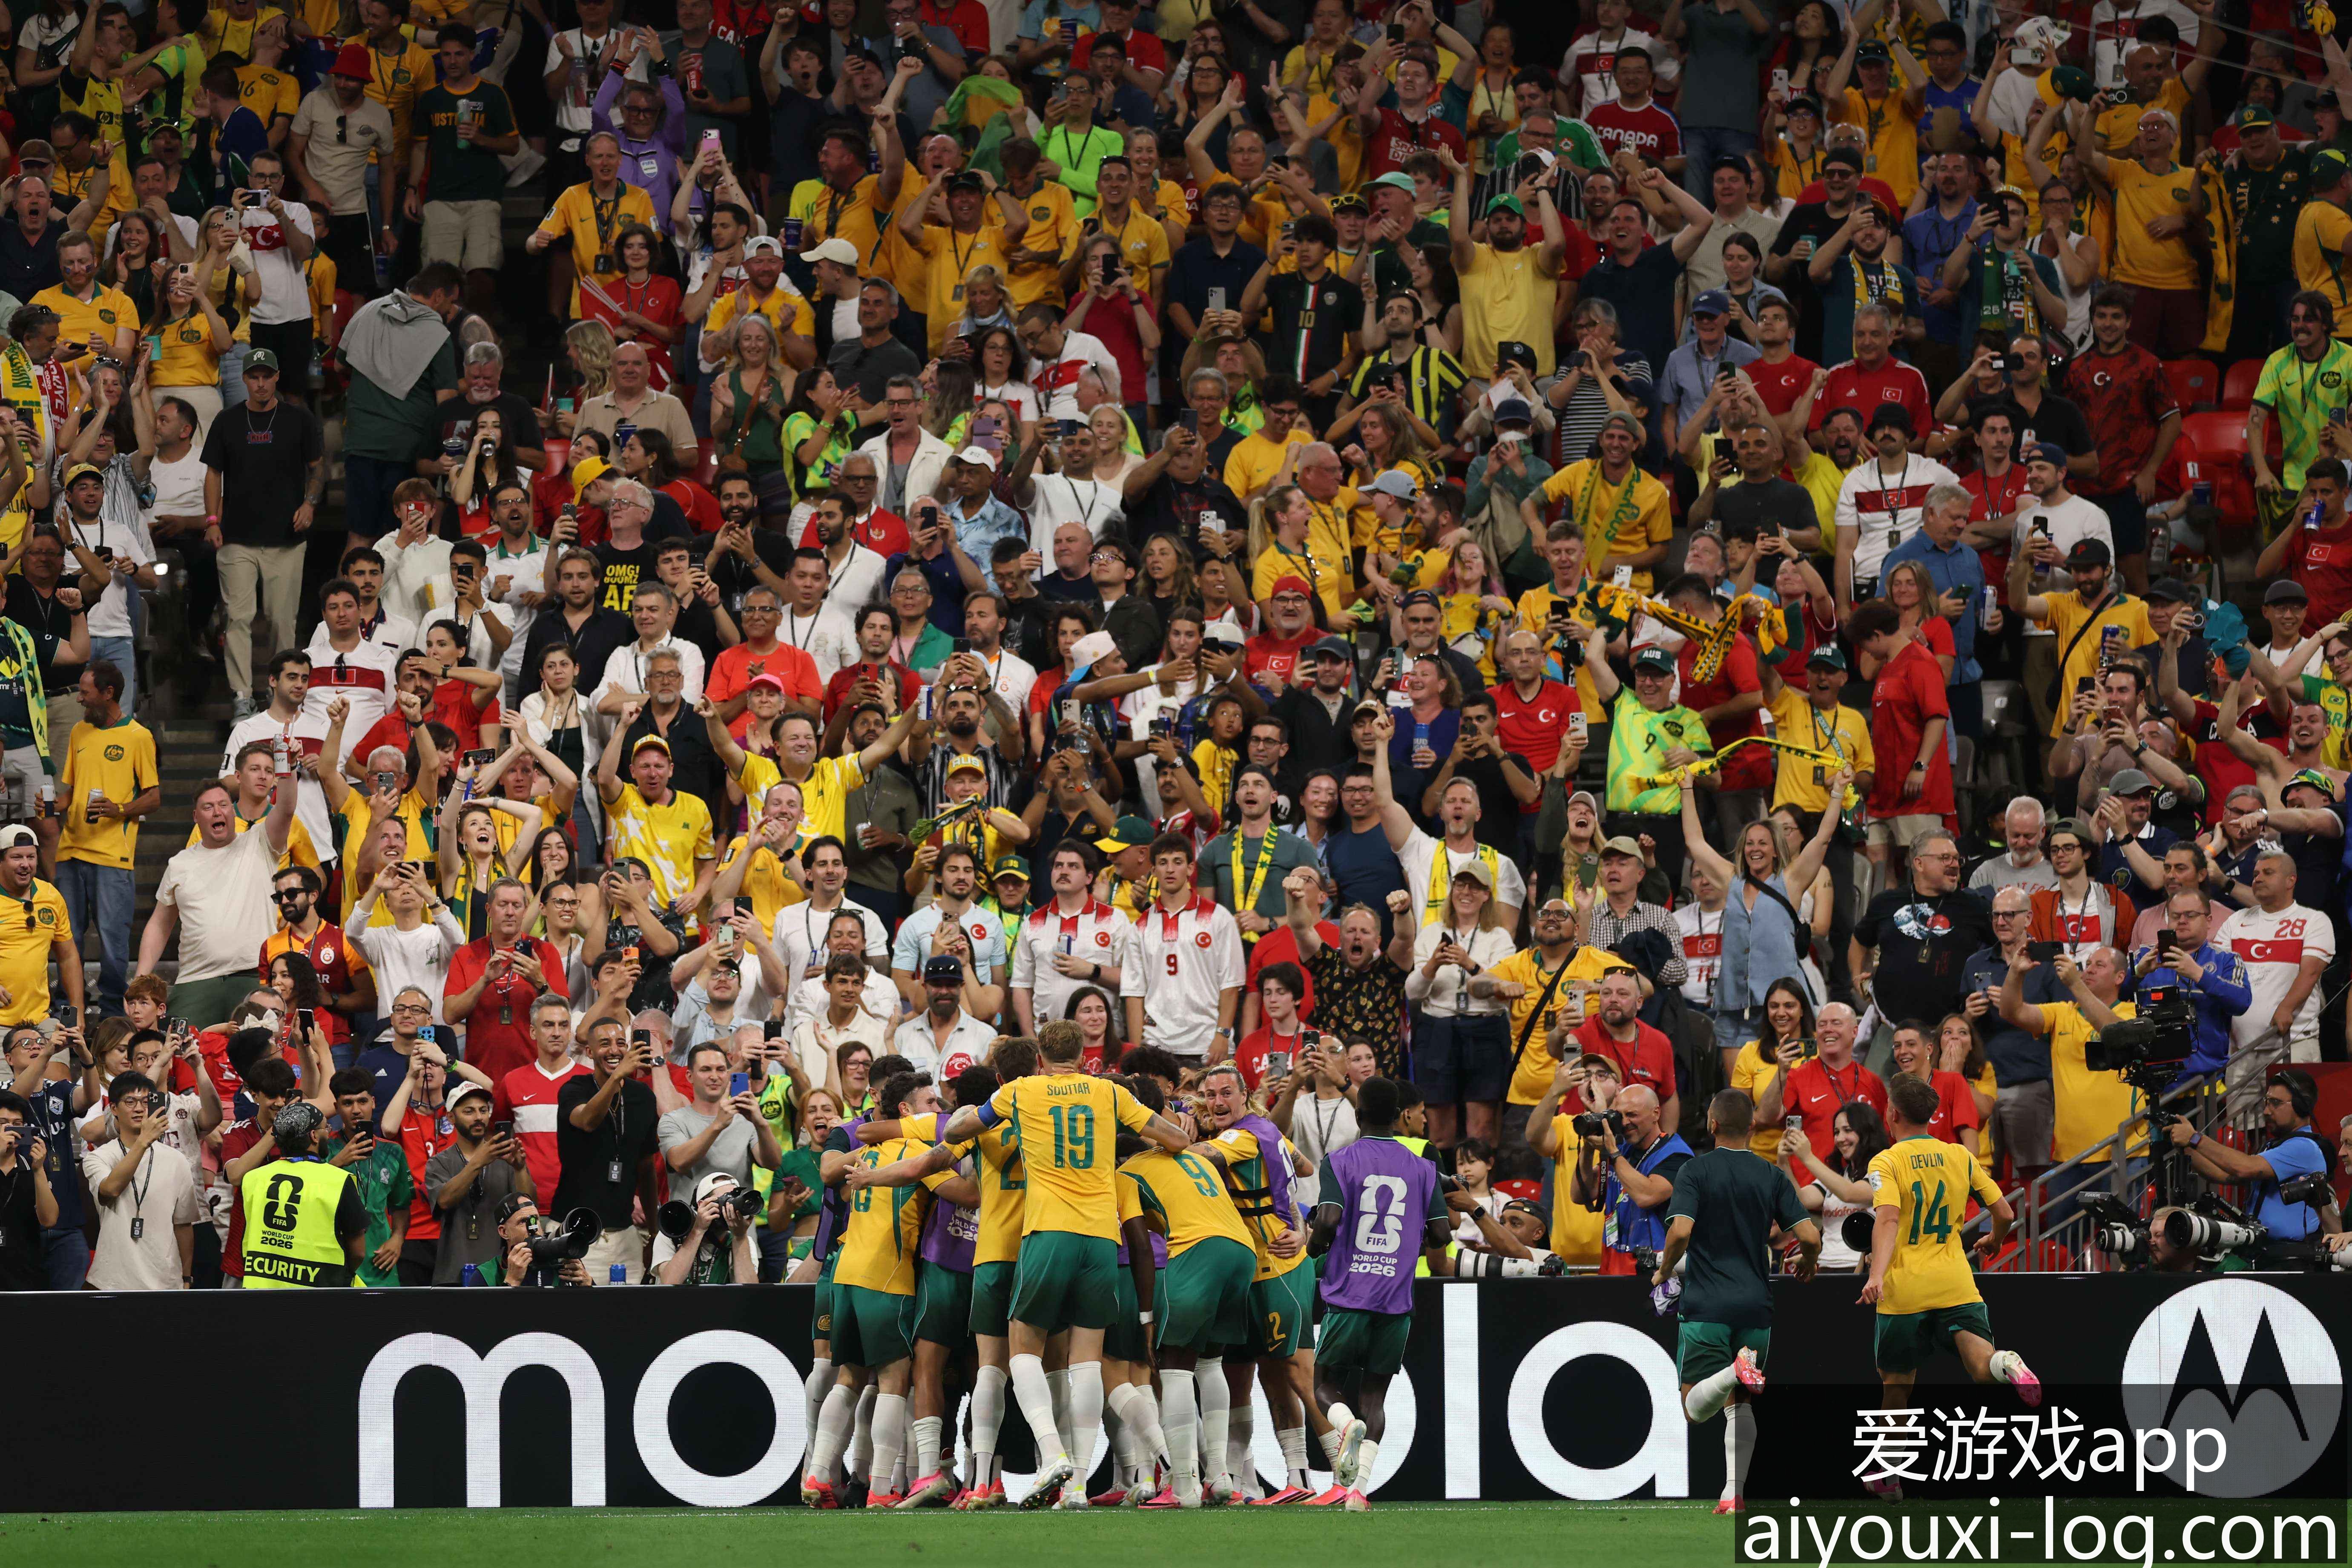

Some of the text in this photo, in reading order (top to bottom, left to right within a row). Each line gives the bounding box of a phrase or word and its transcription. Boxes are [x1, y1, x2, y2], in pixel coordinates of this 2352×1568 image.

[1299, 310, 1315, 328] 10
[606, 565, 640, 577] OMG!
[1642, 649, 1662, 659] AUS
[1814, 646, 1832, 656] AUS
[1644, 733, 1657, 753] 9
[953, 756, 980, 767] AUS
[1002, 859, 1019, 868] AUS
[2274, 918, 2307, 939] 28
[1166, 954, 1178, 976] 9
[1047, 1082, 1090, 1096] SOUTTAR
[1048, 1105, 1095, 1169] 19
[1910, 1152, 1944, 1170] DEVLIN
[1174, 1153, 1219, 1198] 9
[1909, 1179, 1953, 1245] 14
[273, 1217, 287, 1227] FIFA
[262, 1230, 281, 1238] WORLD
[261, 1236, 293, 1250] 2026
[1366, 1237, 1387, 1247] FIFA
[1353, 1254, 1398, 1265] WORLD CUP
[244, 1255, 321, 1283] ECURITY
[1348, 1261, 1396, 1277] 2026
